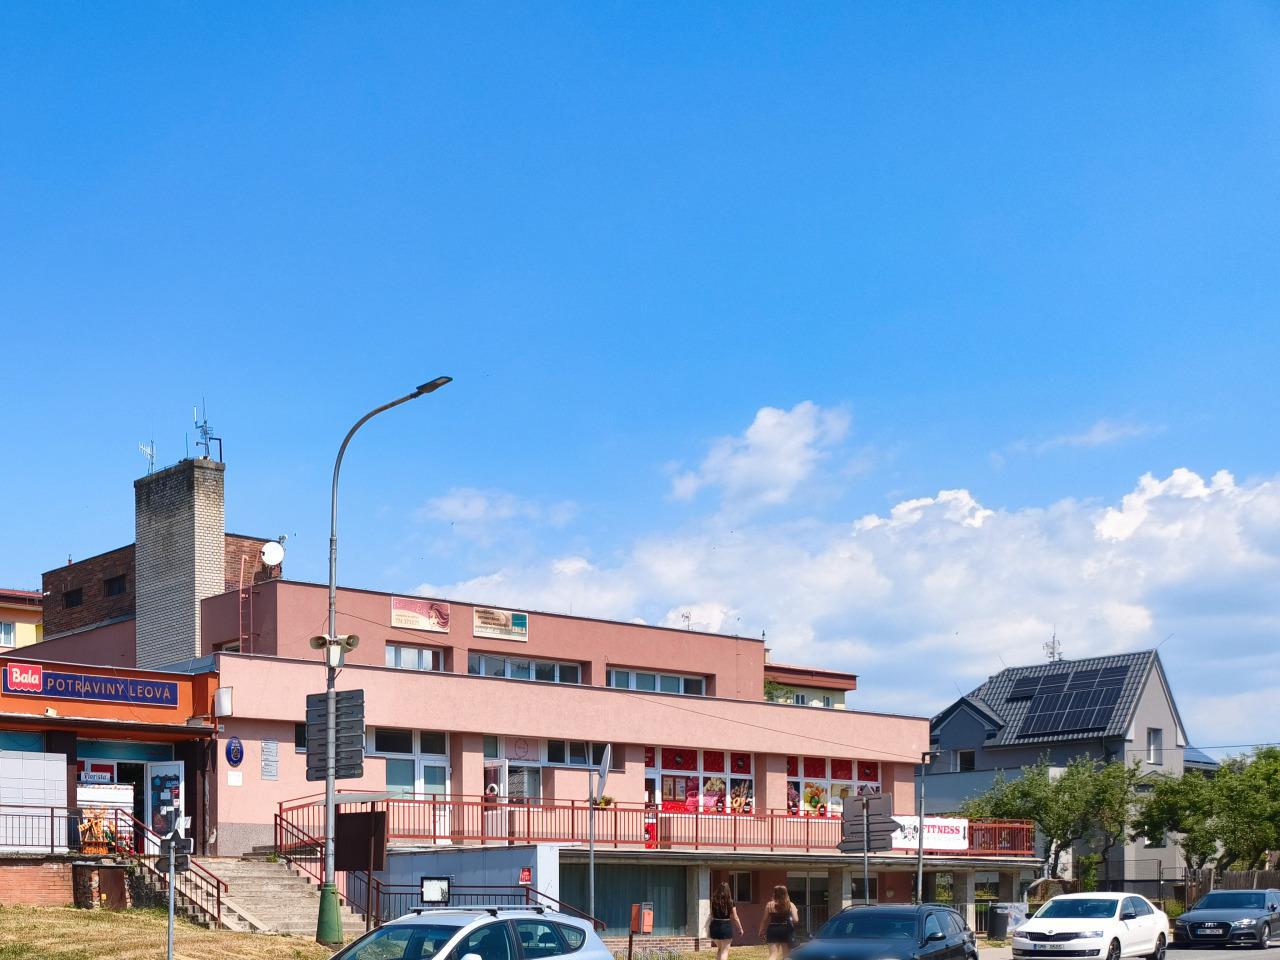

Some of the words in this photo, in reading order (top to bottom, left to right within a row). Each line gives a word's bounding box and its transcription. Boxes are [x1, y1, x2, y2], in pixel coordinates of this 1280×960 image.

[11, 667, 39, 684] Bala
[47, 678, 123, 696] POTRAVINY
[129, 684, 171, 699] LEOVÁ
[921, 824, 961, 835] FITNESS
